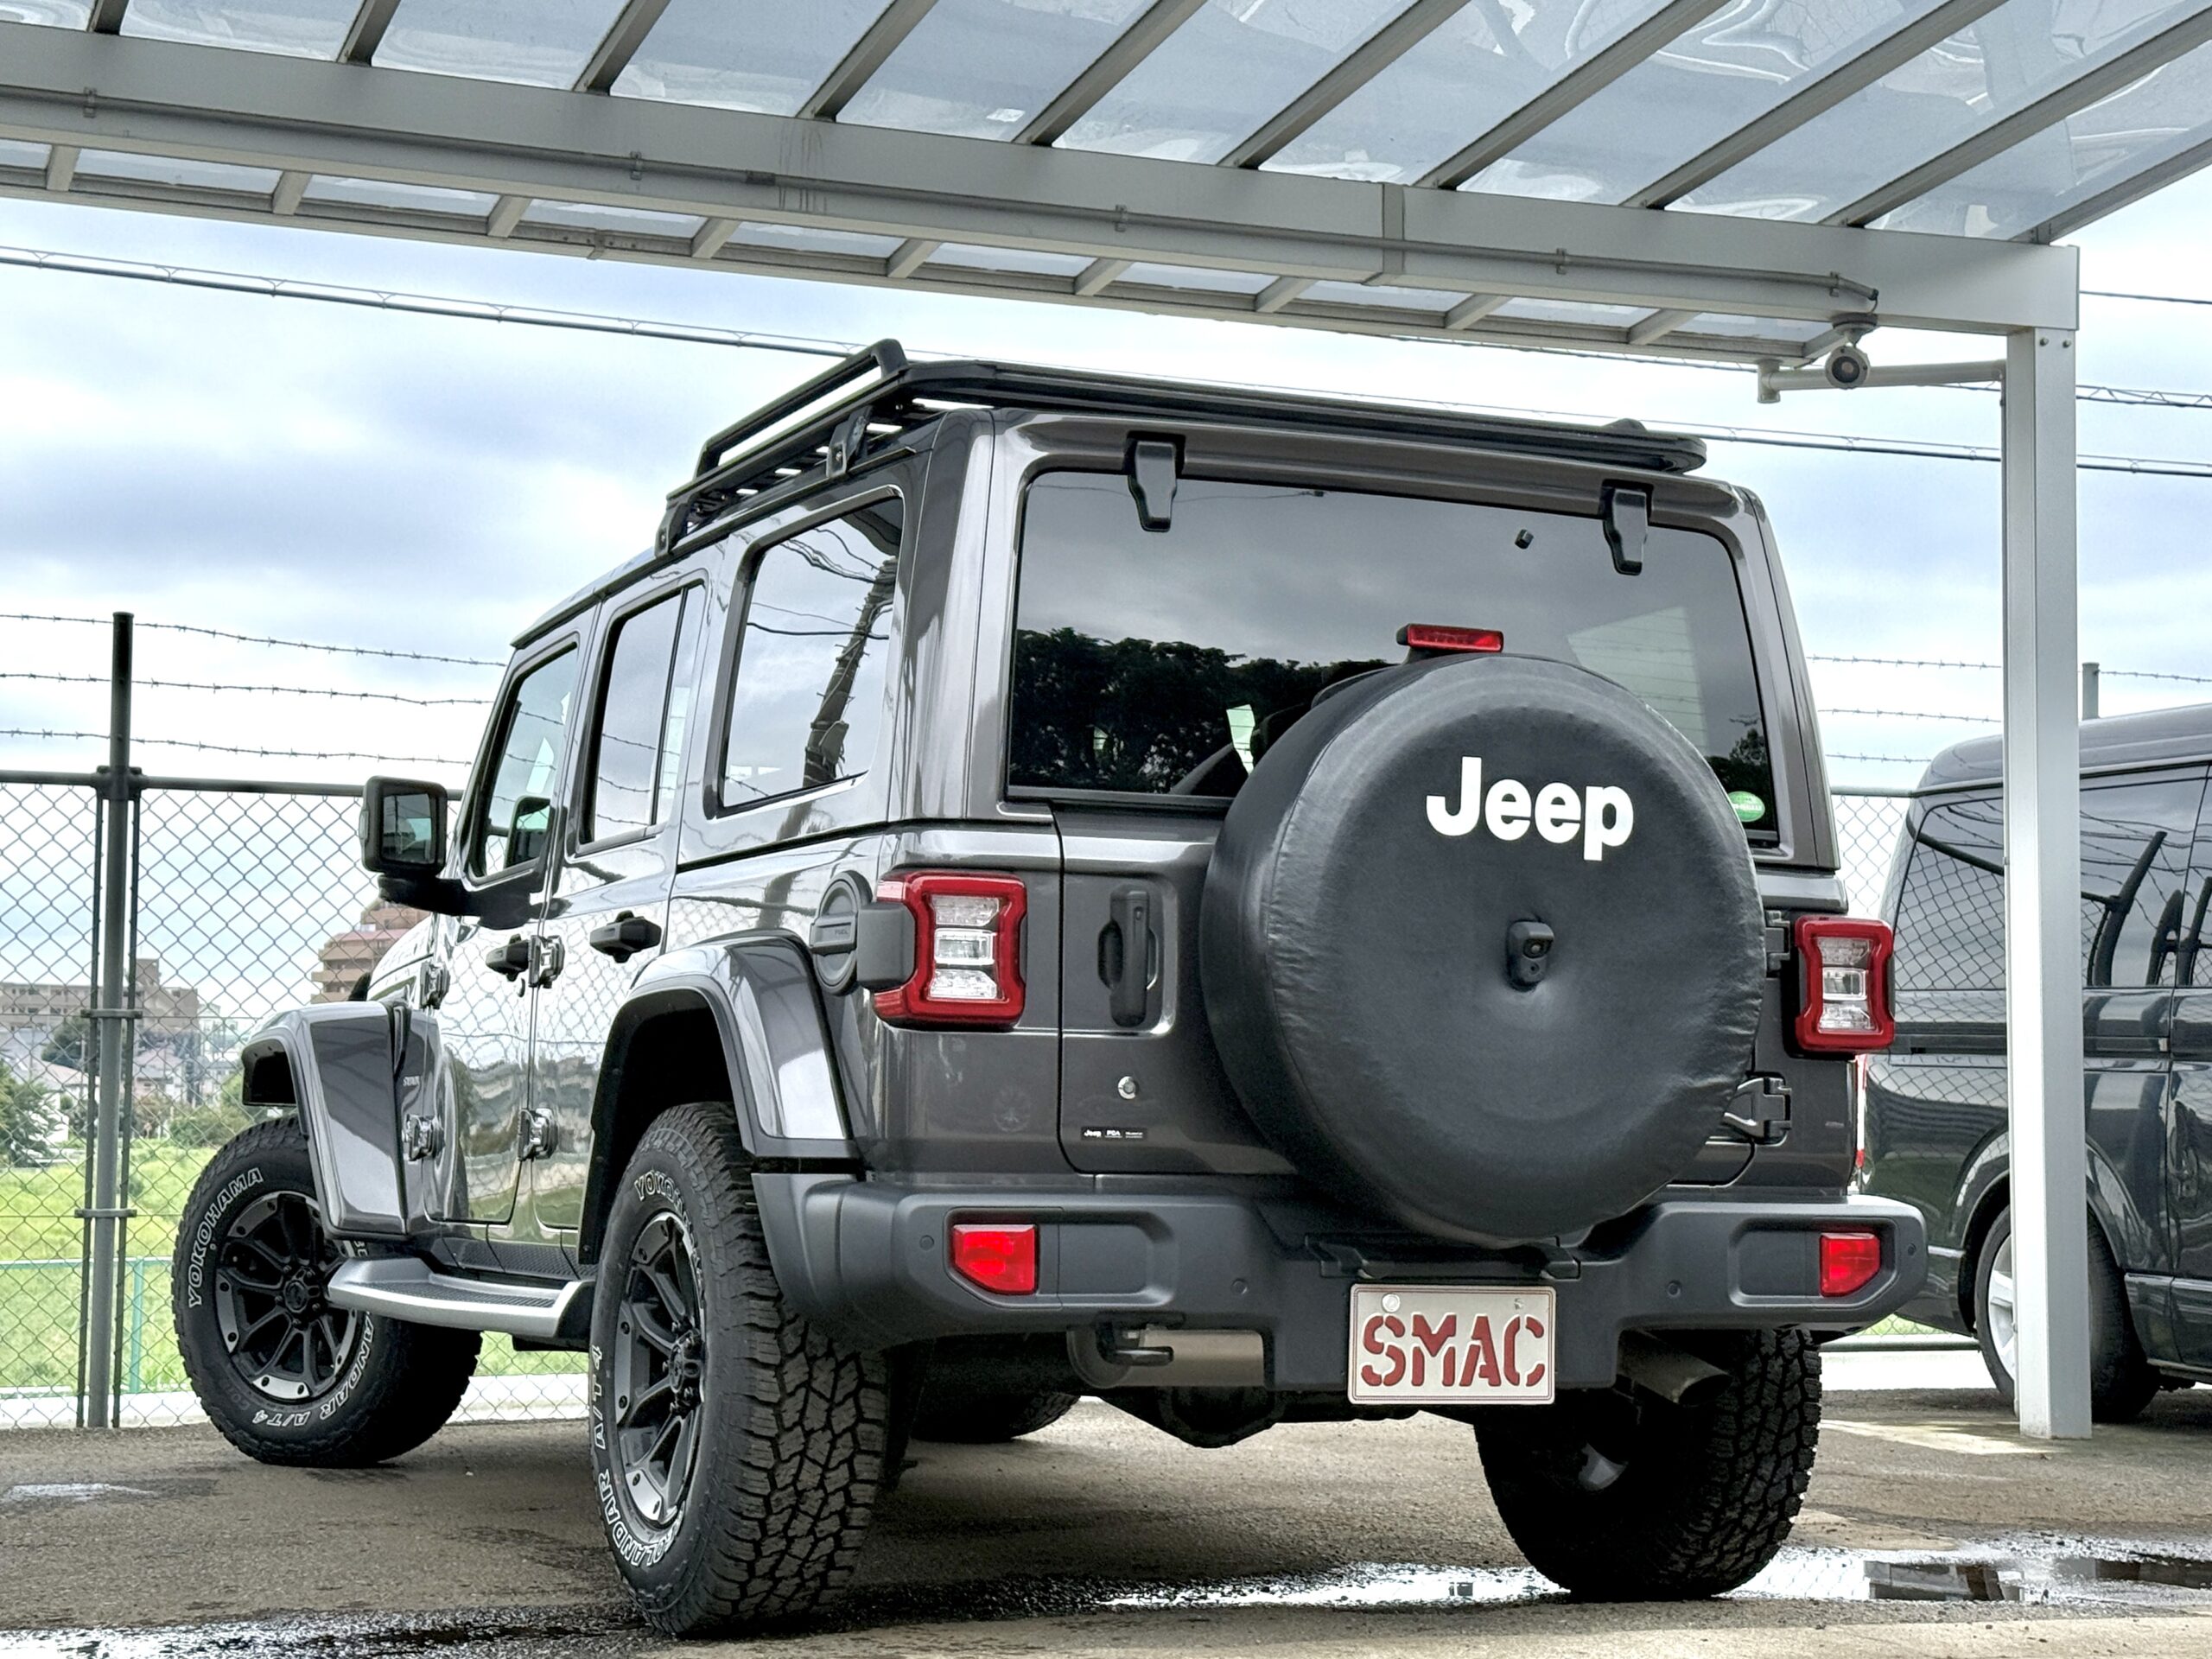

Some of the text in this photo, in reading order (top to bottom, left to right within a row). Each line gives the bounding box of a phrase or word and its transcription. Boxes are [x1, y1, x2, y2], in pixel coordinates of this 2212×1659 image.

[1426, 756, 1634, 861] Jeep
[188, 1167, 264, 1307] YOKOHAMA
[591, 1344, 607, 1450] A/T4
[1361, 1312, 1545, 1387] SMAC
[251, 1409, 311, 1427] A/T4
